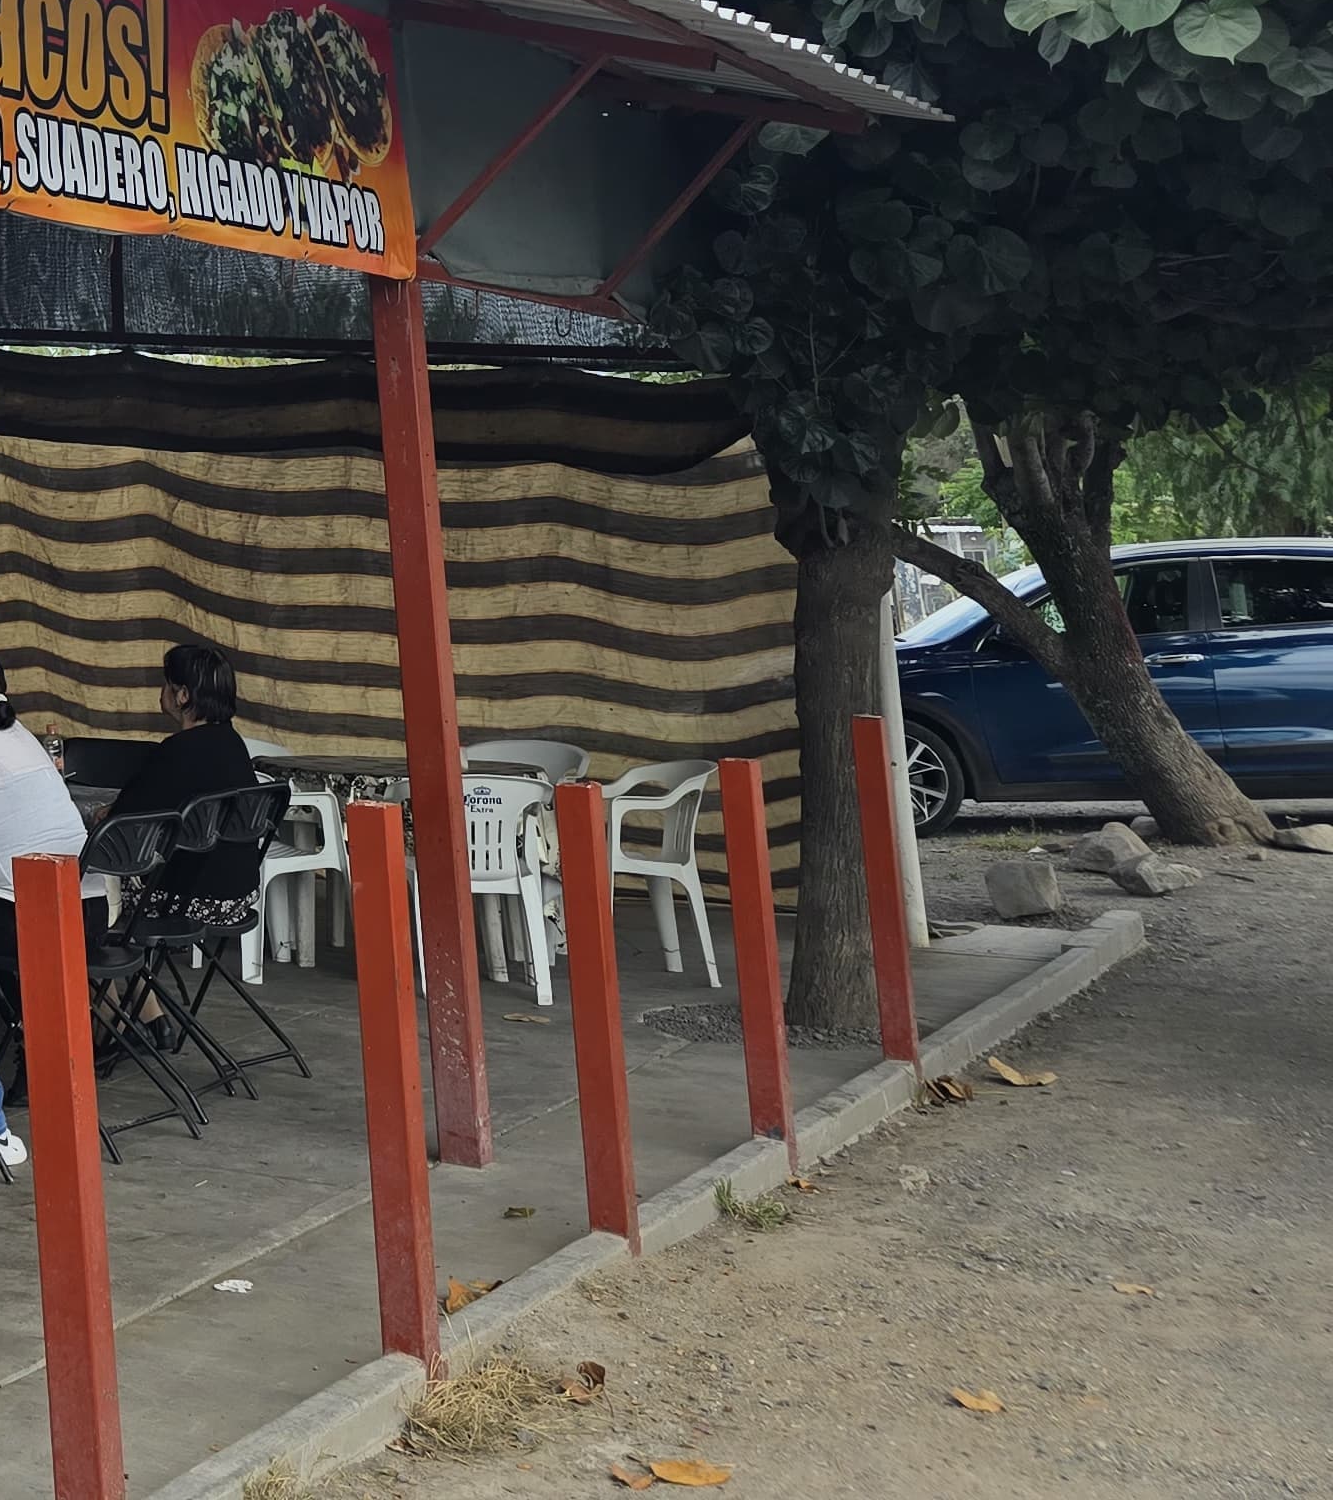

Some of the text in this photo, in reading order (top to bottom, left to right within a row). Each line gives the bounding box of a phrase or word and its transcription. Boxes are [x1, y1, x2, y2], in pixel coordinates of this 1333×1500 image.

[17, 112, 178, 219] SUADERO,
[175, 147, 285, 233] HIGADO
[284, 171, 302, 236] Y
[303, 177, 385, 252] VAPOR
[463, 794, 502, 806] Corona
